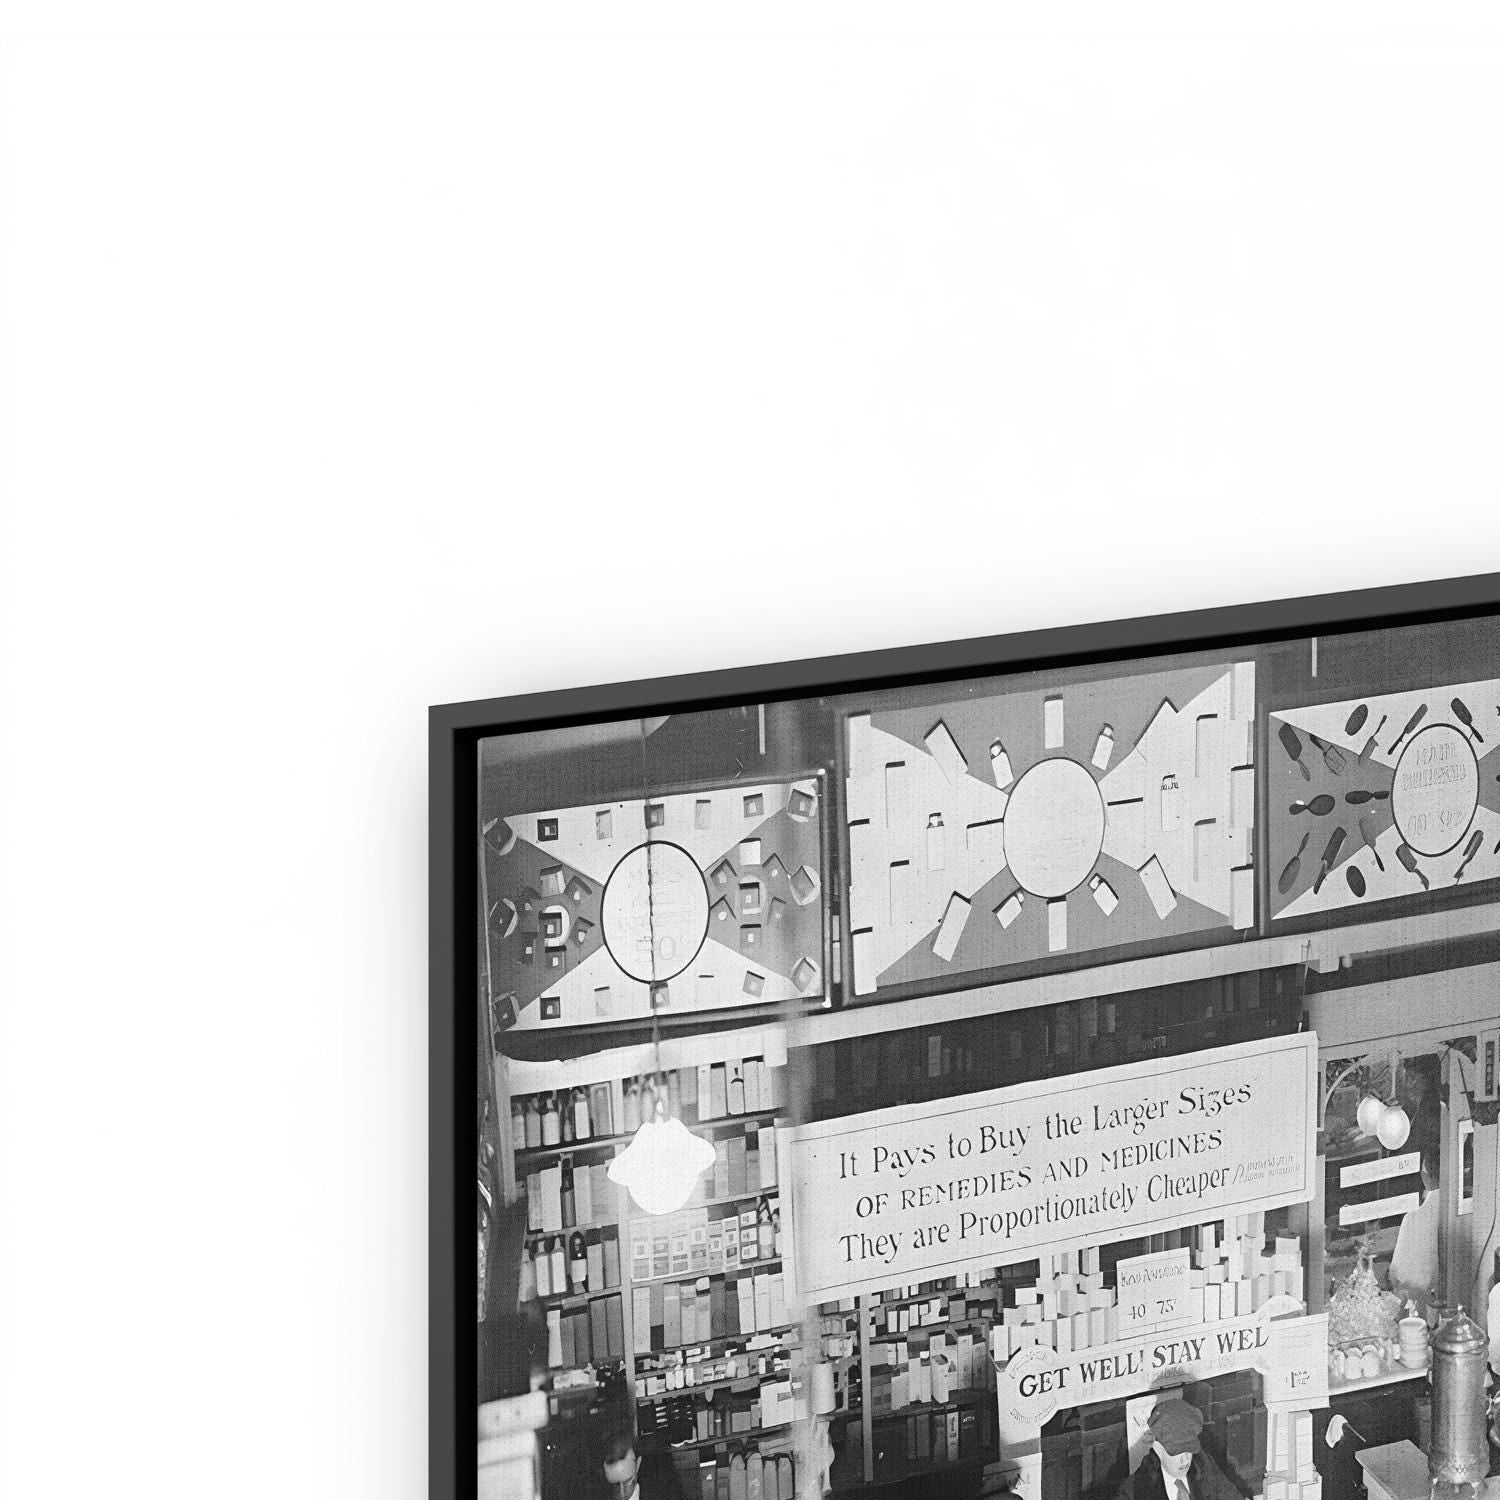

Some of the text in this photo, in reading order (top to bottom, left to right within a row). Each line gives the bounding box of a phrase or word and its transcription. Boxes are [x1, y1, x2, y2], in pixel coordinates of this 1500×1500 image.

[839, 1084, 1252, 1179] It Pays to Buy the Larger Sizes
[855, 1193, 887, 1218] OF
[900, 1166, 1033, 1210] REMEDIES
[1042, 1156, 1088, 1183] AND
[1100, 1129, 1223, 1173] MEDICINES
[838, 1231, 902, 1264] They
[912, 1222, 950, 1250] are
[959, 1182, 1139, 1240] Proportionately
[1147, 1167, 1231, 1203] Cheaper
[1019, 1366, 1070, 1398] GET
[1080, 1349, 1145, 1384] WELL!
[1152, 1337, 1206, 1369] STAY
